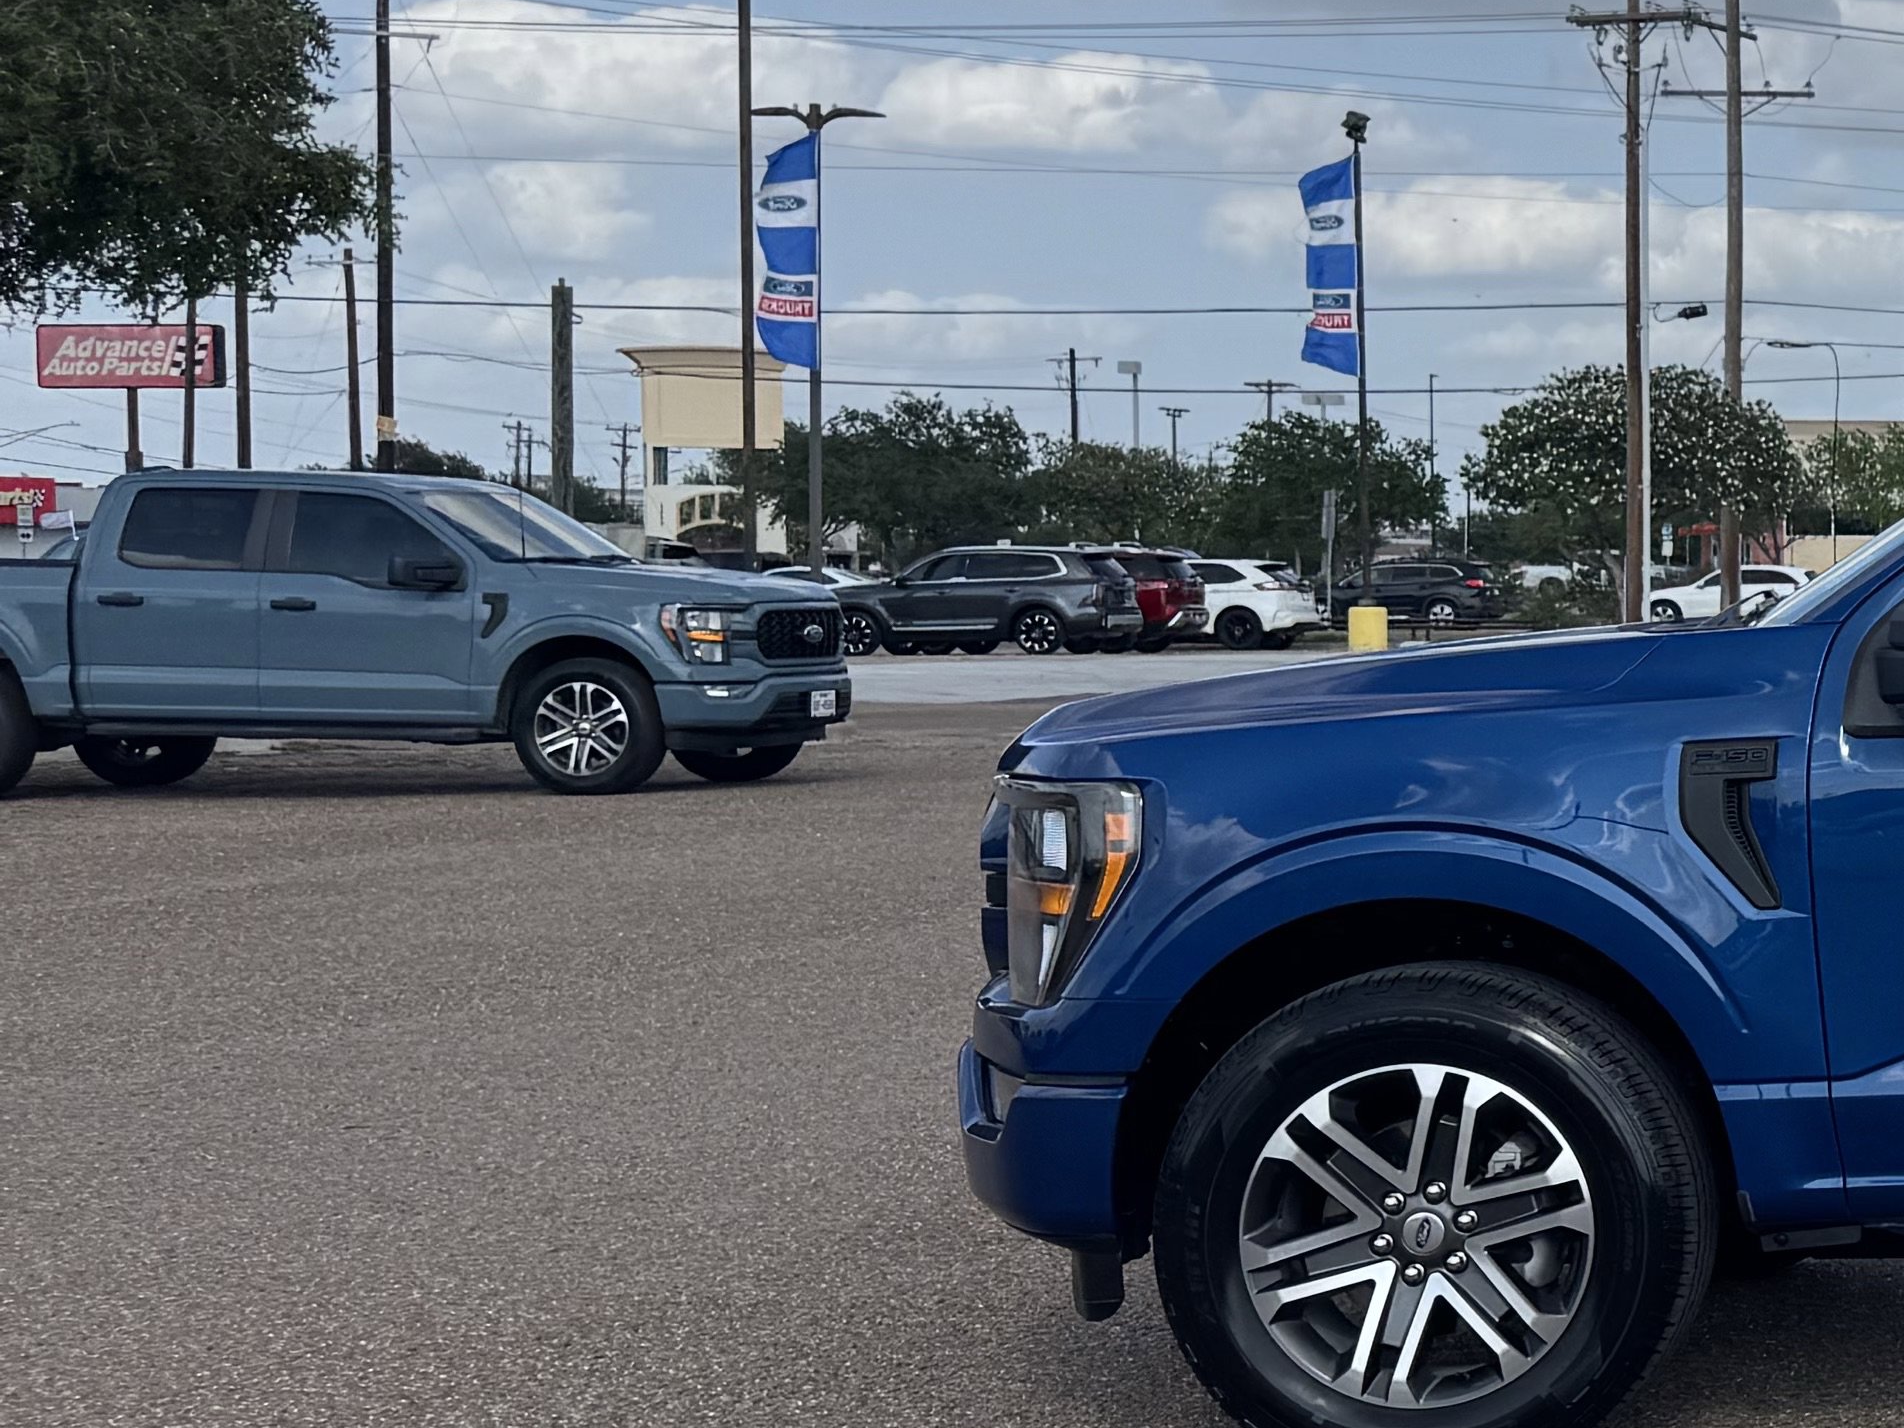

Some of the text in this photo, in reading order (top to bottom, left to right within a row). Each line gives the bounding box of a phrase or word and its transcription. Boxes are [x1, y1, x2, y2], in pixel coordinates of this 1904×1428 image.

[55, 335, 166, 358] Advance
[42, 358, 162, 376] Auto Parts
[1691, 747, 1769, 764] F-150
